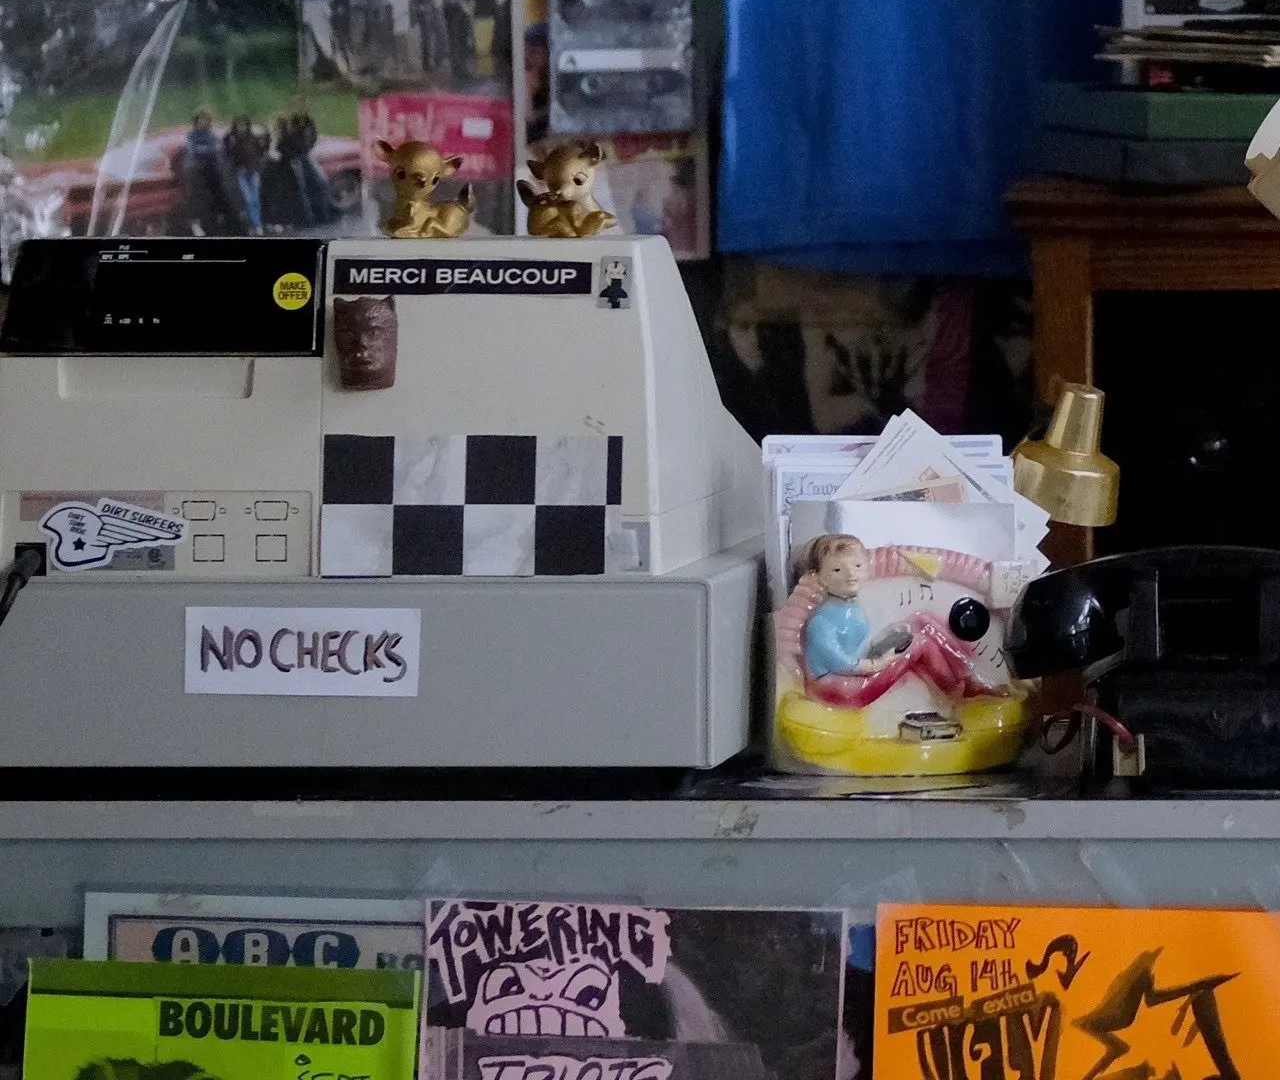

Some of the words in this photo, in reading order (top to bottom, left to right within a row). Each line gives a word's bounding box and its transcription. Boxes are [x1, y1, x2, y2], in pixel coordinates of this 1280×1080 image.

[277, 290, 308, 301] OFFER
[279, 280, 307, 291] MAKE
[349, 267, 428, 285] MERCI
[435, 267, 578, 286] BEAUCOUP
[101, 503, 130, 519] DIRT
[131, 511, 184, 533] SURFERS
[200, 625, 262, 672] NO
[267, 627, 408, 683] CHECKS
[429, 902, 658, 1000] TOWERING
[894, 916, 1022, 955] FRIDAY
[890, 960, 958, 998] AUG
[970, 957, 1022, 993] 14th
[159, 1000, 385, 1047] BOULEVARD
[901, 1003, 962, 1030] Come
[982, 988, 1035, 1017] extra
